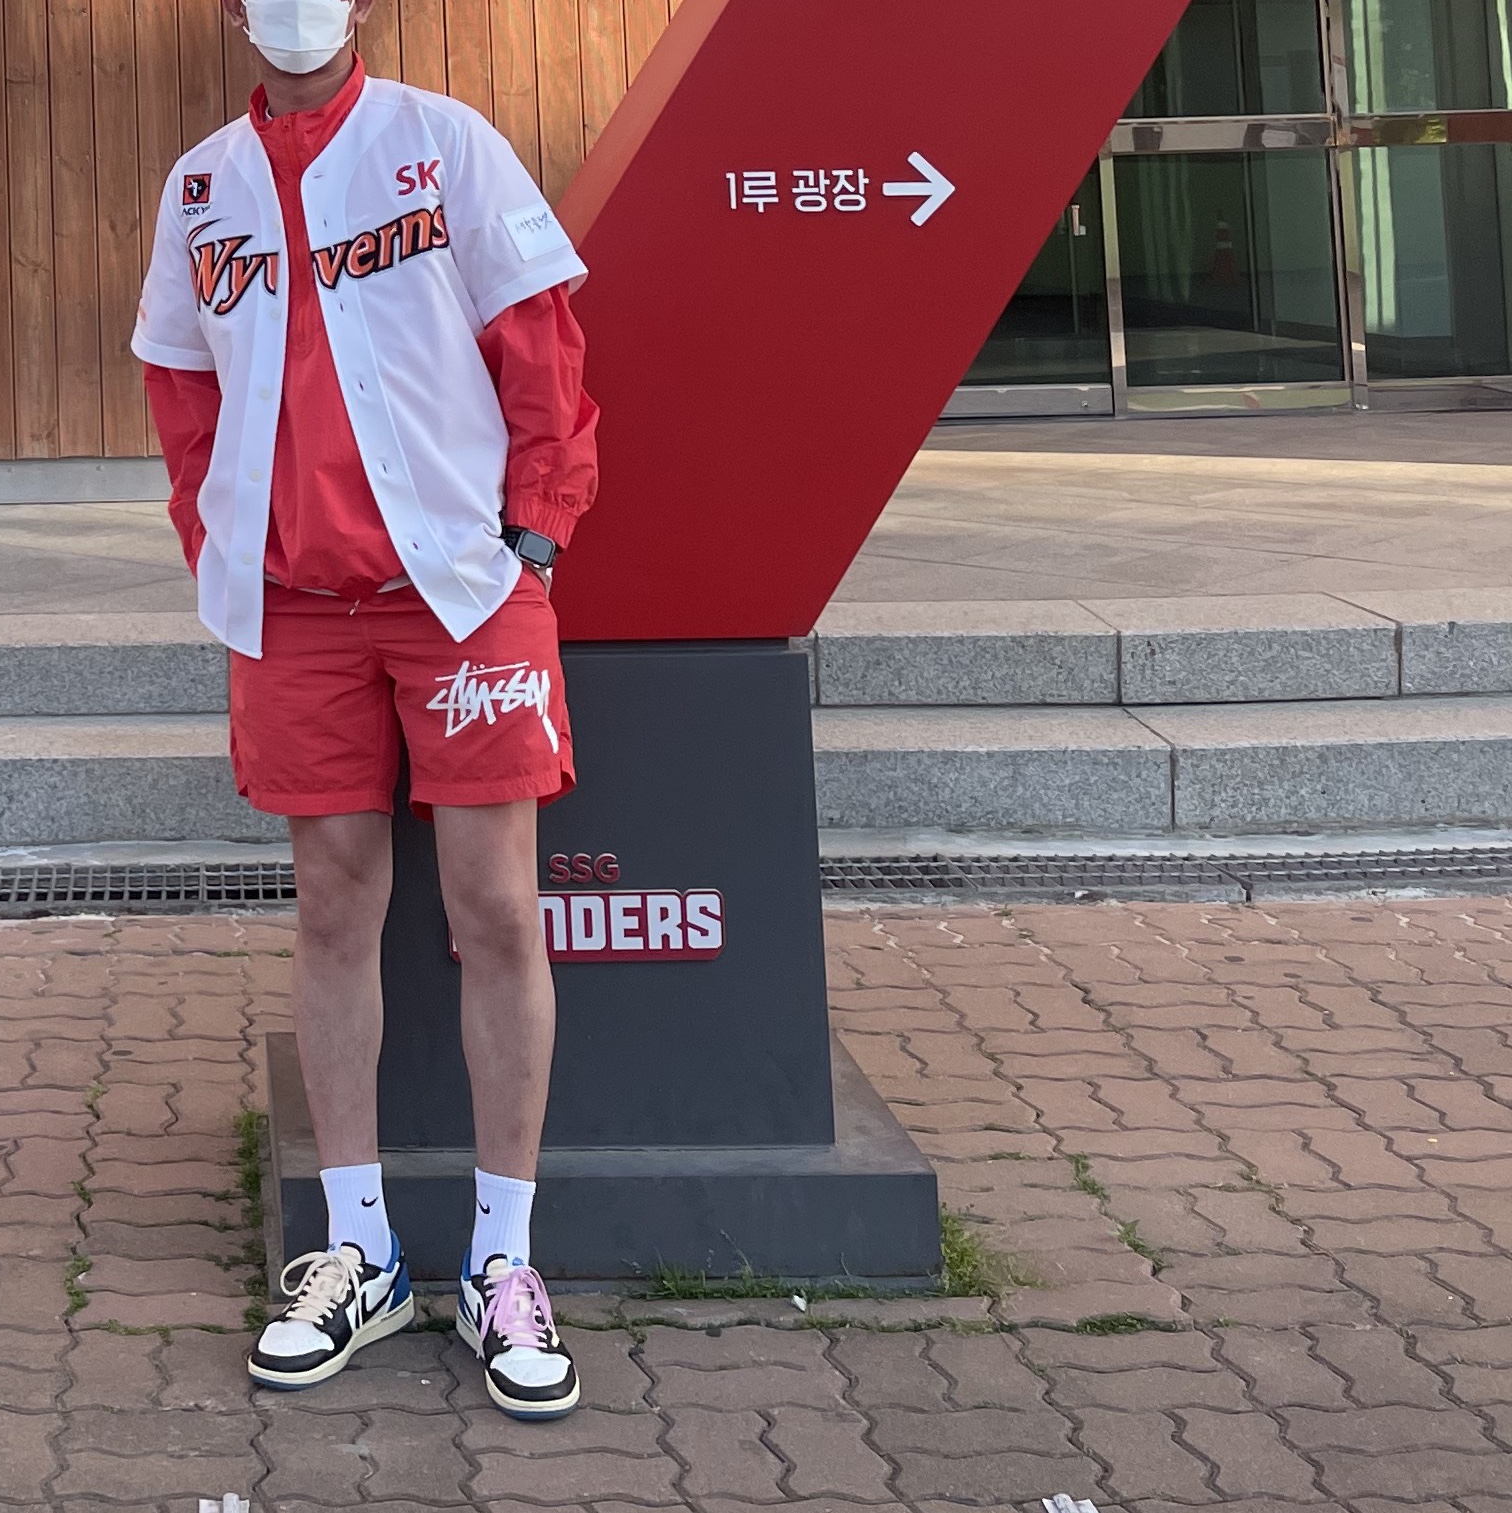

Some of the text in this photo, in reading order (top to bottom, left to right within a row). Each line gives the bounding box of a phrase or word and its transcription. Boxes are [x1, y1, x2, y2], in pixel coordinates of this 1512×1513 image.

[395, 159, 440, 196] SK
[726, 168, 869, 213] 1루 광장
[549, 852, 621, 884] SSG
